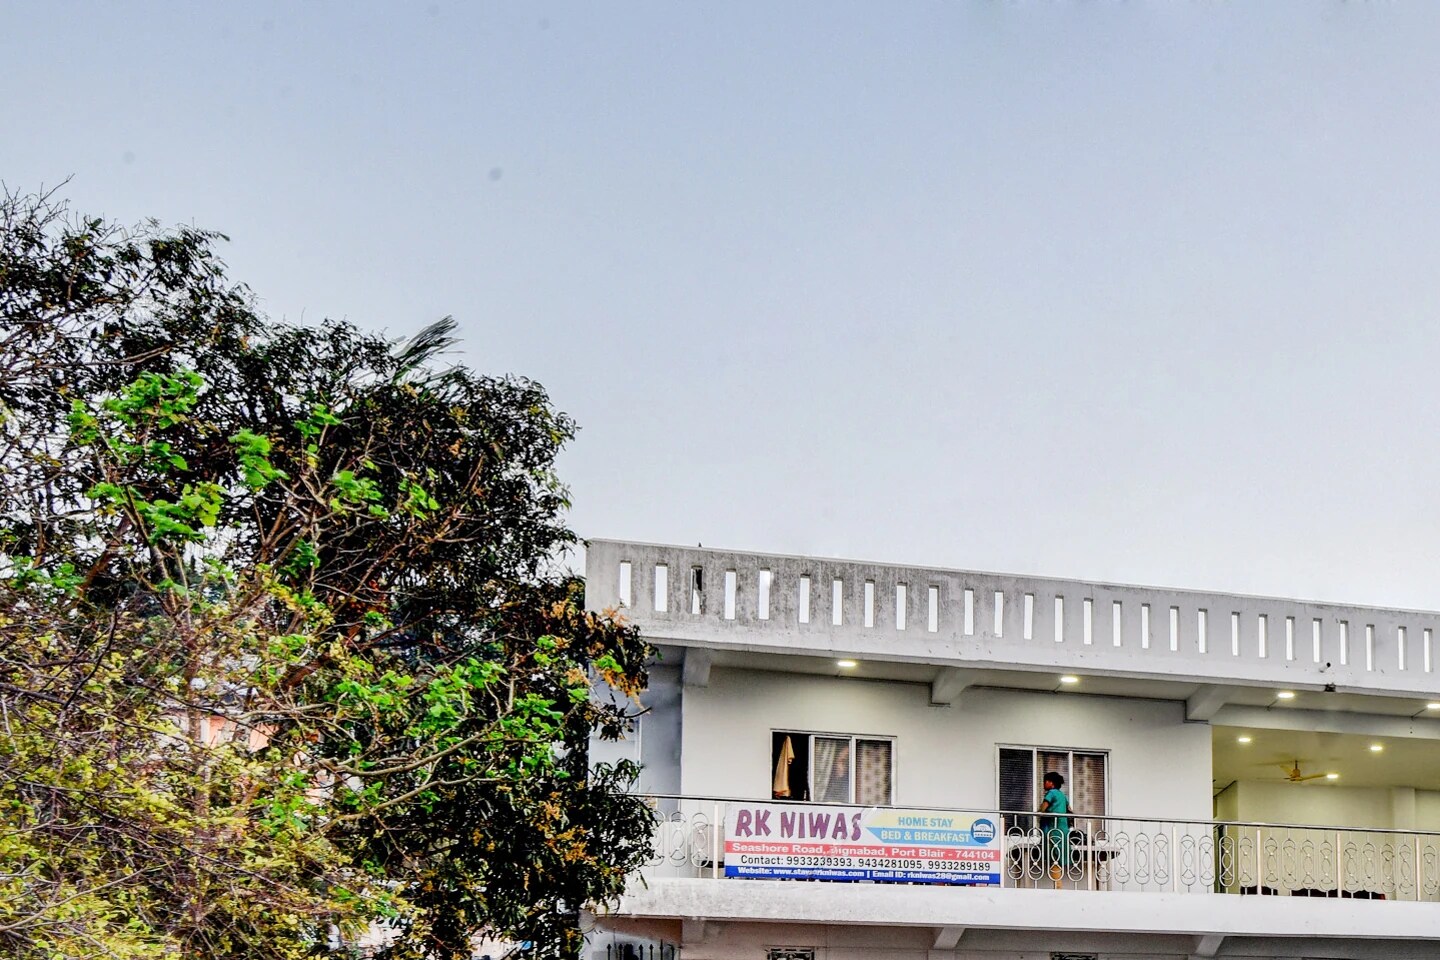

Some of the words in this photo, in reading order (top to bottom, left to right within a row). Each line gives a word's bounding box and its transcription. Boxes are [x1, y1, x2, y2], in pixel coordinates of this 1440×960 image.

[735, 809, 772, 838] RK
[780, 811, 862, 841] NIWAS
[898, 817, 928, 827] HOME
[930, 818, 954, 828] STAY
[881, 830, 901, 840] BED
[904, 831, 912, 841] &
[914, 832, 971, 843] BREAKFAST
[732, 843, 789, 853] Seashore
[792, 844, 827, 855] Road,
[891, 848, 916, 857] Port
[919, 849, 945, 858] Blair
[955, 850, 995, 860] 744104
[741, 854, 784, 865] Contact:
[928, 860, 991, 871] 9933289189
[737, 866, 772, 875] Website:
[872, 870, 894, 878] Email
